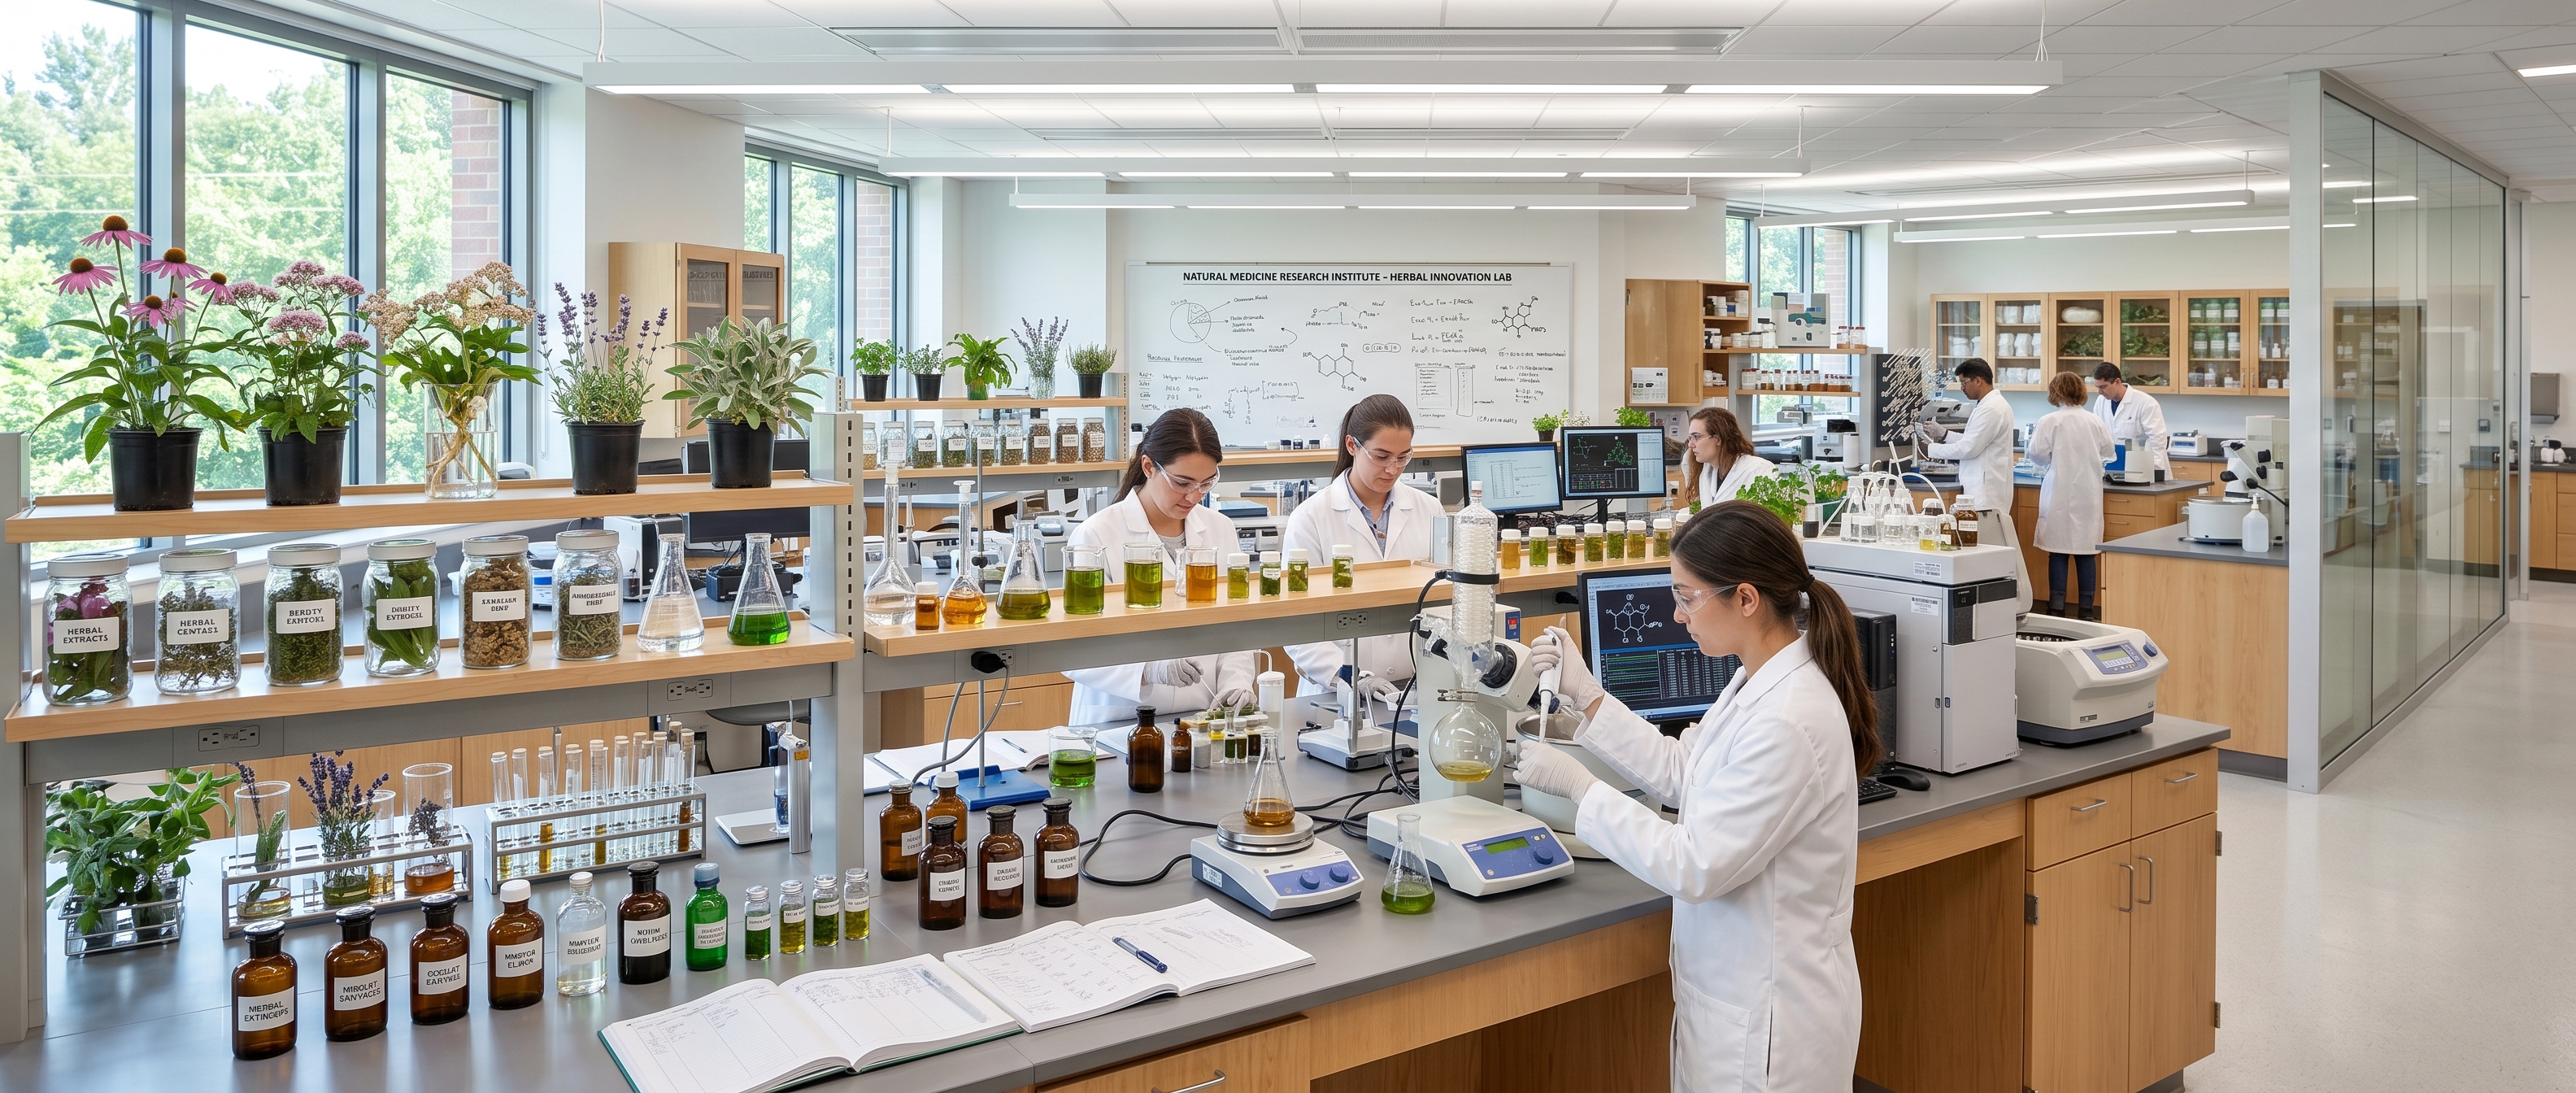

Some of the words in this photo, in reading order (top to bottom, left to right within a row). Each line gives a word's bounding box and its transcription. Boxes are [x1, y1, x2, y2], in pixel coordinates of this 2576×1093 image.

[1184, 272, 1227, 281] NATURAL
[1230, 272, 1277, 281] MEDICINE
[1281, 272, 1328, 281] RESEARCH
[1332, 272, 1380, 281] INSTITUTE
[1390, 272, 1428, 281] HERBAL
[1431, 272, 1490, 281] INNOVATION
[1495, 272, 1512, 281] LAB
[68, 627, 102, 635] HERBAL
[63, 634, 108, 643] EXTRACTS
